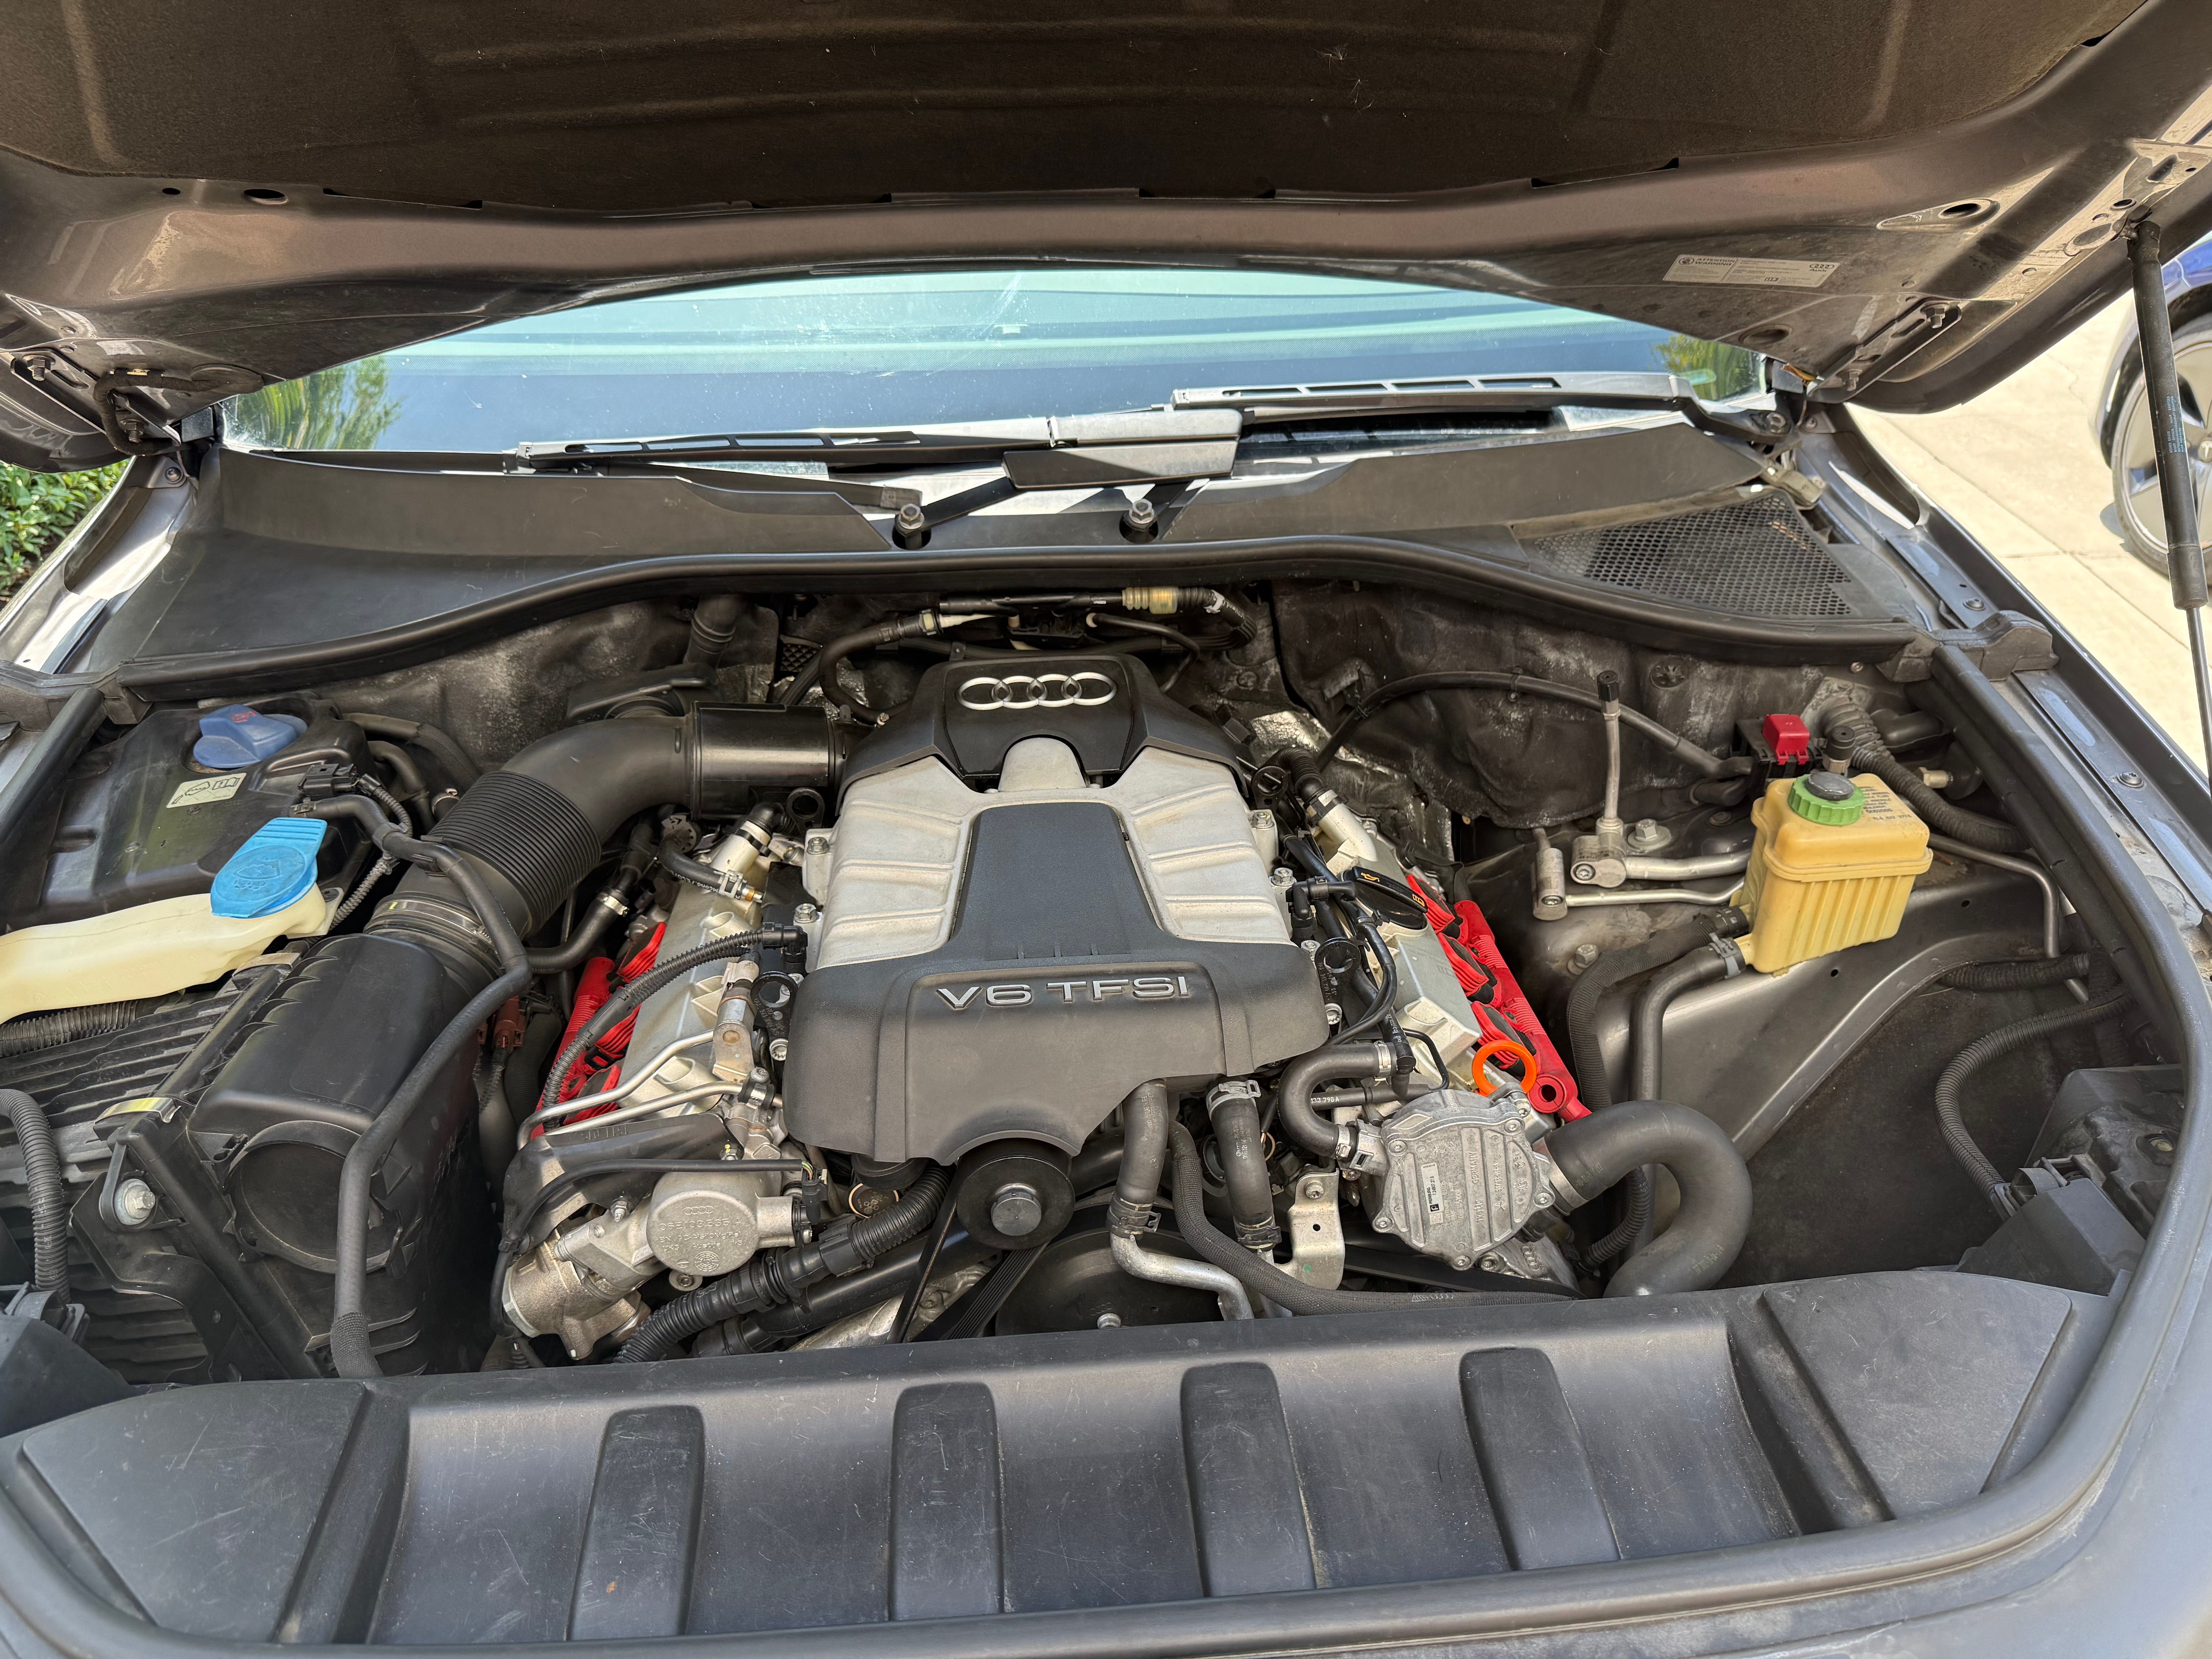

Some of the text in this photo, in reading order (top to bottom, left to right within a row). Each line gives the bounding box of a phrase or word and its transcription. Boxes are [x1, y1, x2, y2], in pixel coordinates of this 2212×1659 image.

[936, 976, 1188, 1010] V6 TFSI
[1469, 1152, 1479, 1184] GERMANY
